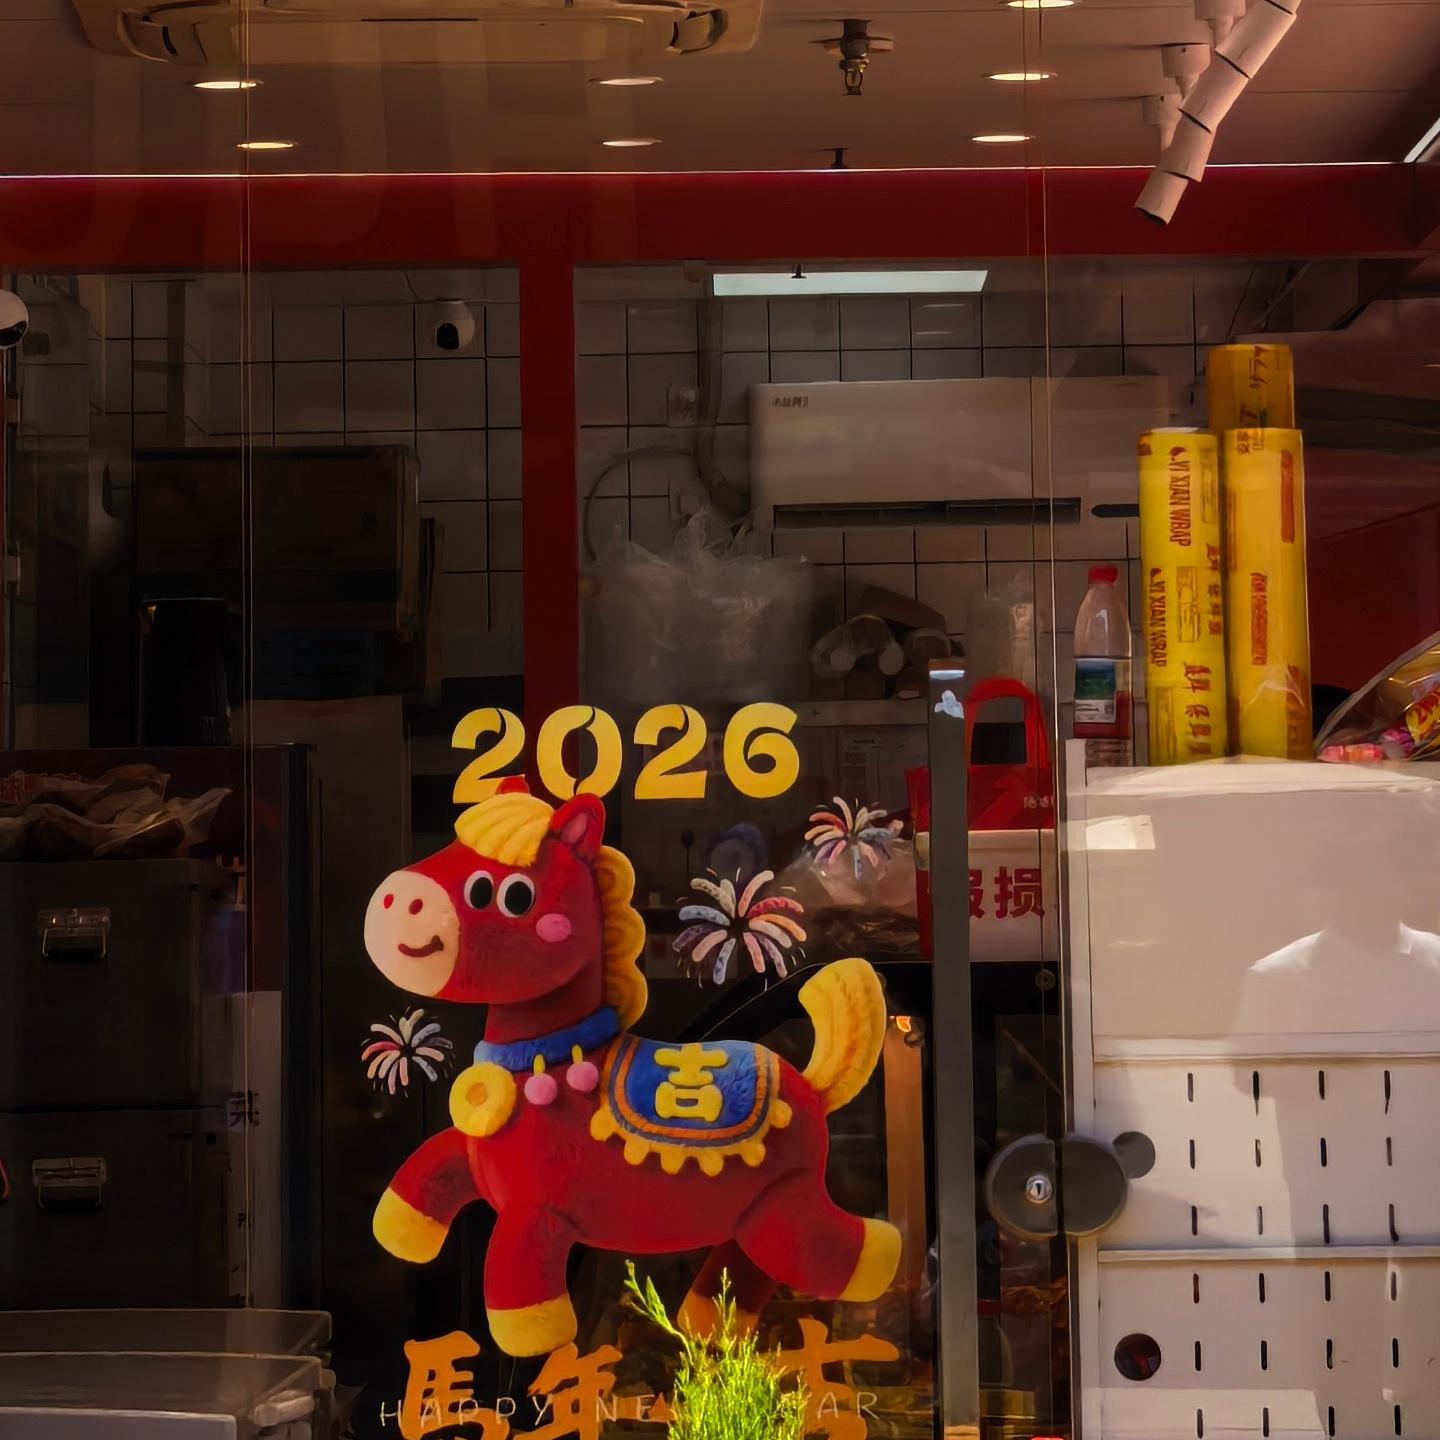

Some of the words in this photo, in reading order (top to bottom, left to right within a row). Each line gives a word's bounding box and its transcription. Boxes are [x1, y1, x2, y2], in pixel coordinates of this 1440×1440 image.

[452, 703, 800, 802] 2026
[654, 1044, 731, 1121] 吉
[380, 1395, 553, 1427] HAPPY
